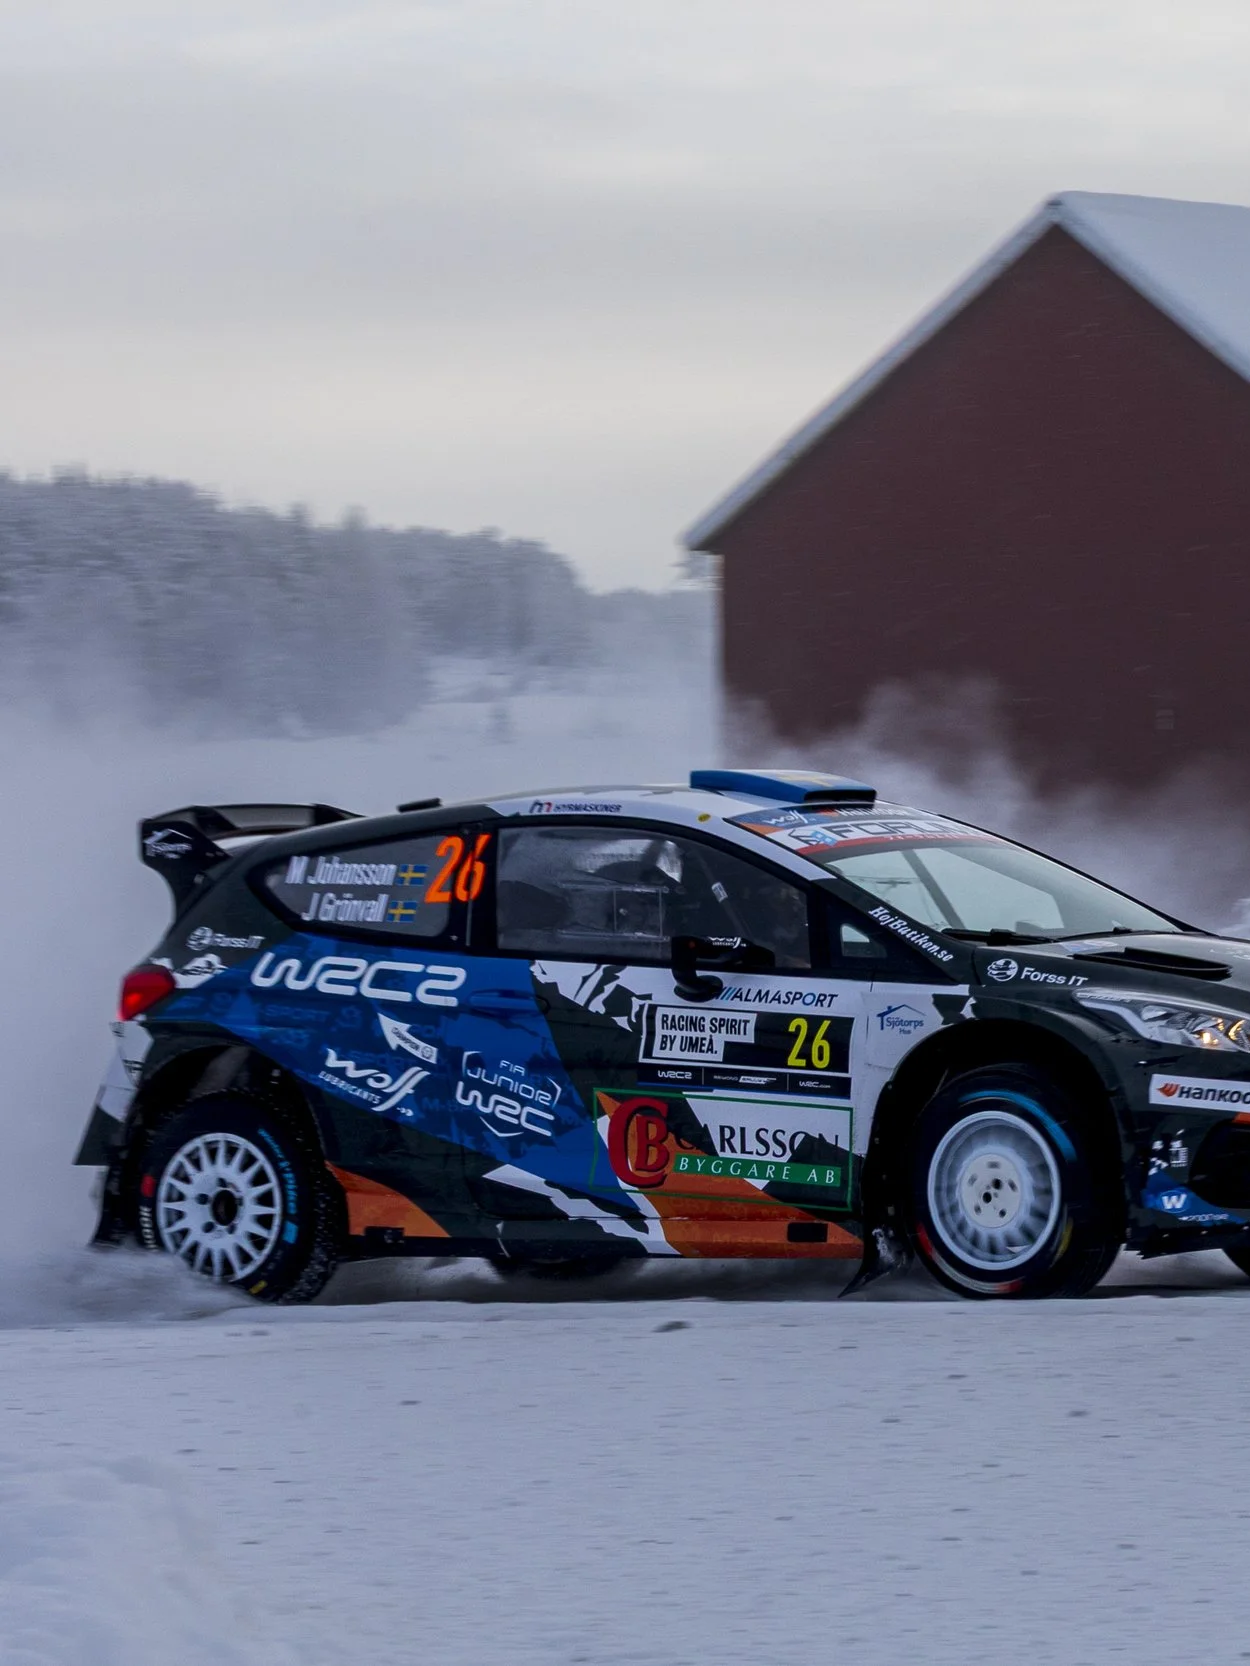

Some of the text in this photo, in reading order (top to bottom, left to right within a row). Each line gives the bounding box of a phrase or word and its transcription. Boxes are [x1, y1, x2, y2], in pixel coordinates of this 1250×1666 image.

[285, 855, 397, 885] M Johansson
[424, 833, 492, 903] 26
[301, 892, 389, 922] J Grönvall
[251, 952, 467, 1007] WRC2
[1020, 966, 1089, 987] Forss IT
[730, 987, 839, 1008] ALMASPORT
[661, 1013, 750, 1036] RACING SPIRIT
[659, 1034, 678, 1052] BY
[787, 1017, 832, 1069] 26
[499, 1059, 526, 1077] FIA
[657, 1069, 693, 1080] WRC2
[466, 1066, 552, 1106] JUNIOR
[455, 1080, 555, 1137] WRC
[679, 1158, 835, 1184] BYGGARE AB
